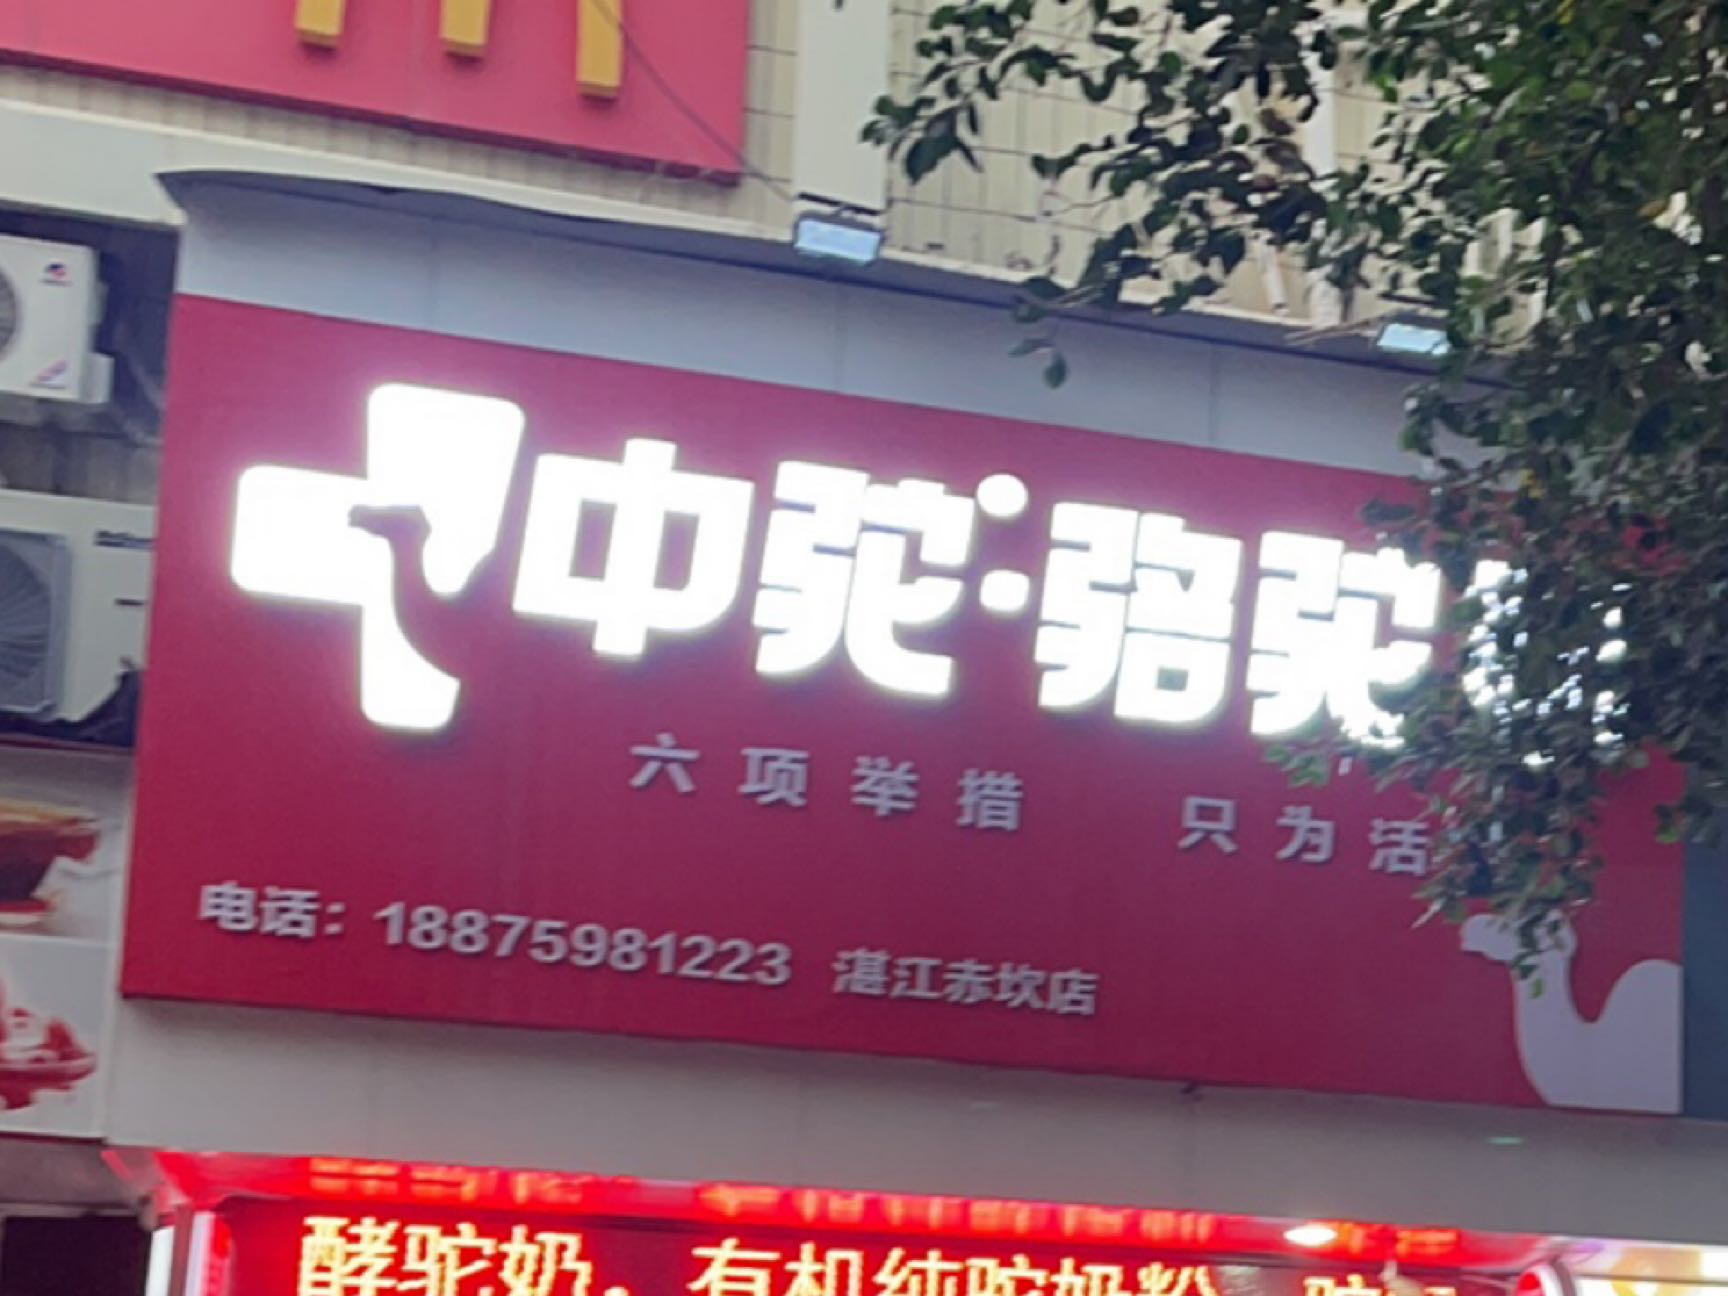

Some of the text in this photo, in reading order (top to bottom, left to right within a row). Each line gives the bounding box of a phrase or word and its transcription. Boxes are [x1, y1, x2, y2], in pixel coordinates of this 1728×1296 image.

[628, 733, 1024, 832] 六项举措
[373, 901, 792, 986] 18875981223
[831, 947, 1098, 1016] 湛江赤坎店
